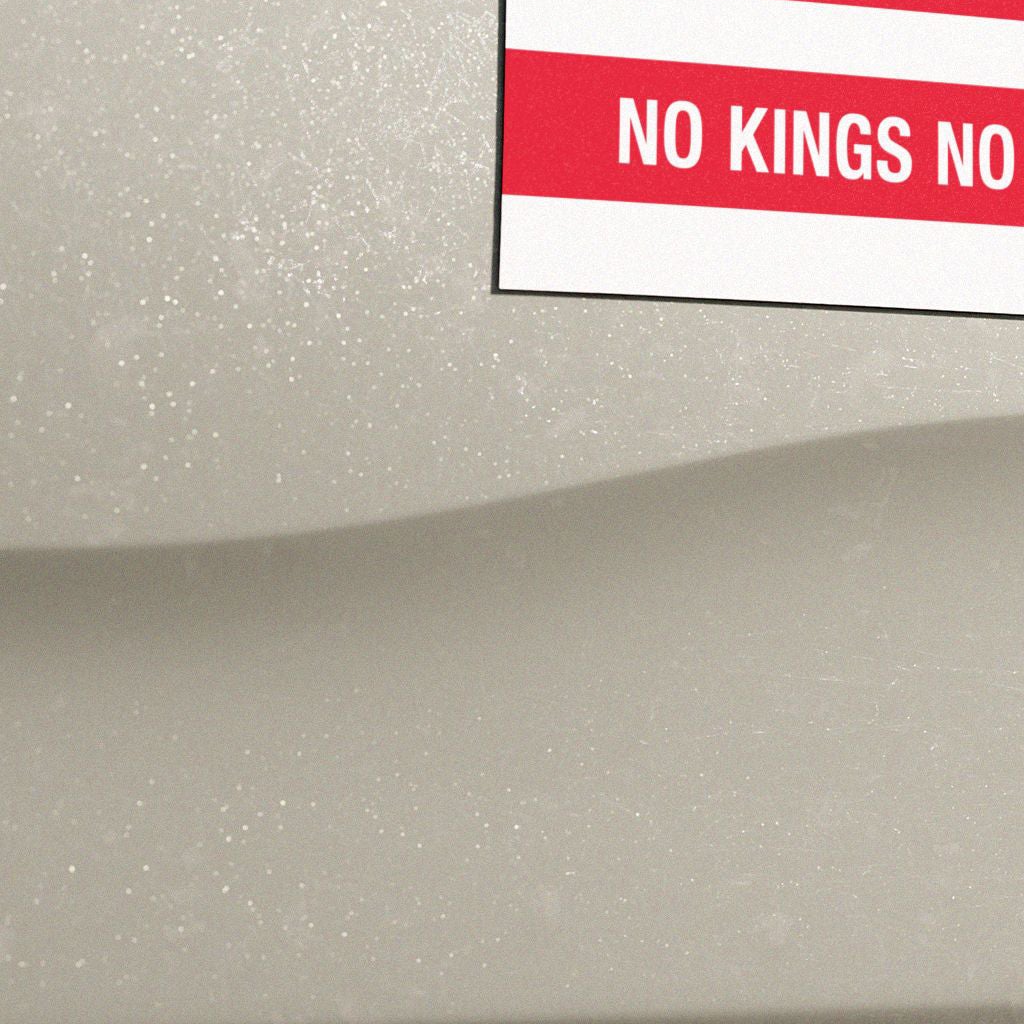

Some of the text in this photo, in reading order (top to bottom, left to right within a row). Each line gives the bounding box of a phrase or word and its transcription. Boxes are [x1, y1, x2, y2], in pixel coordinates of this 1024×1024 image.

[617, 96, 704, 170] NO
[728, 104, 914, 185] KINGS
[936, 119, 1016, 192] NO
